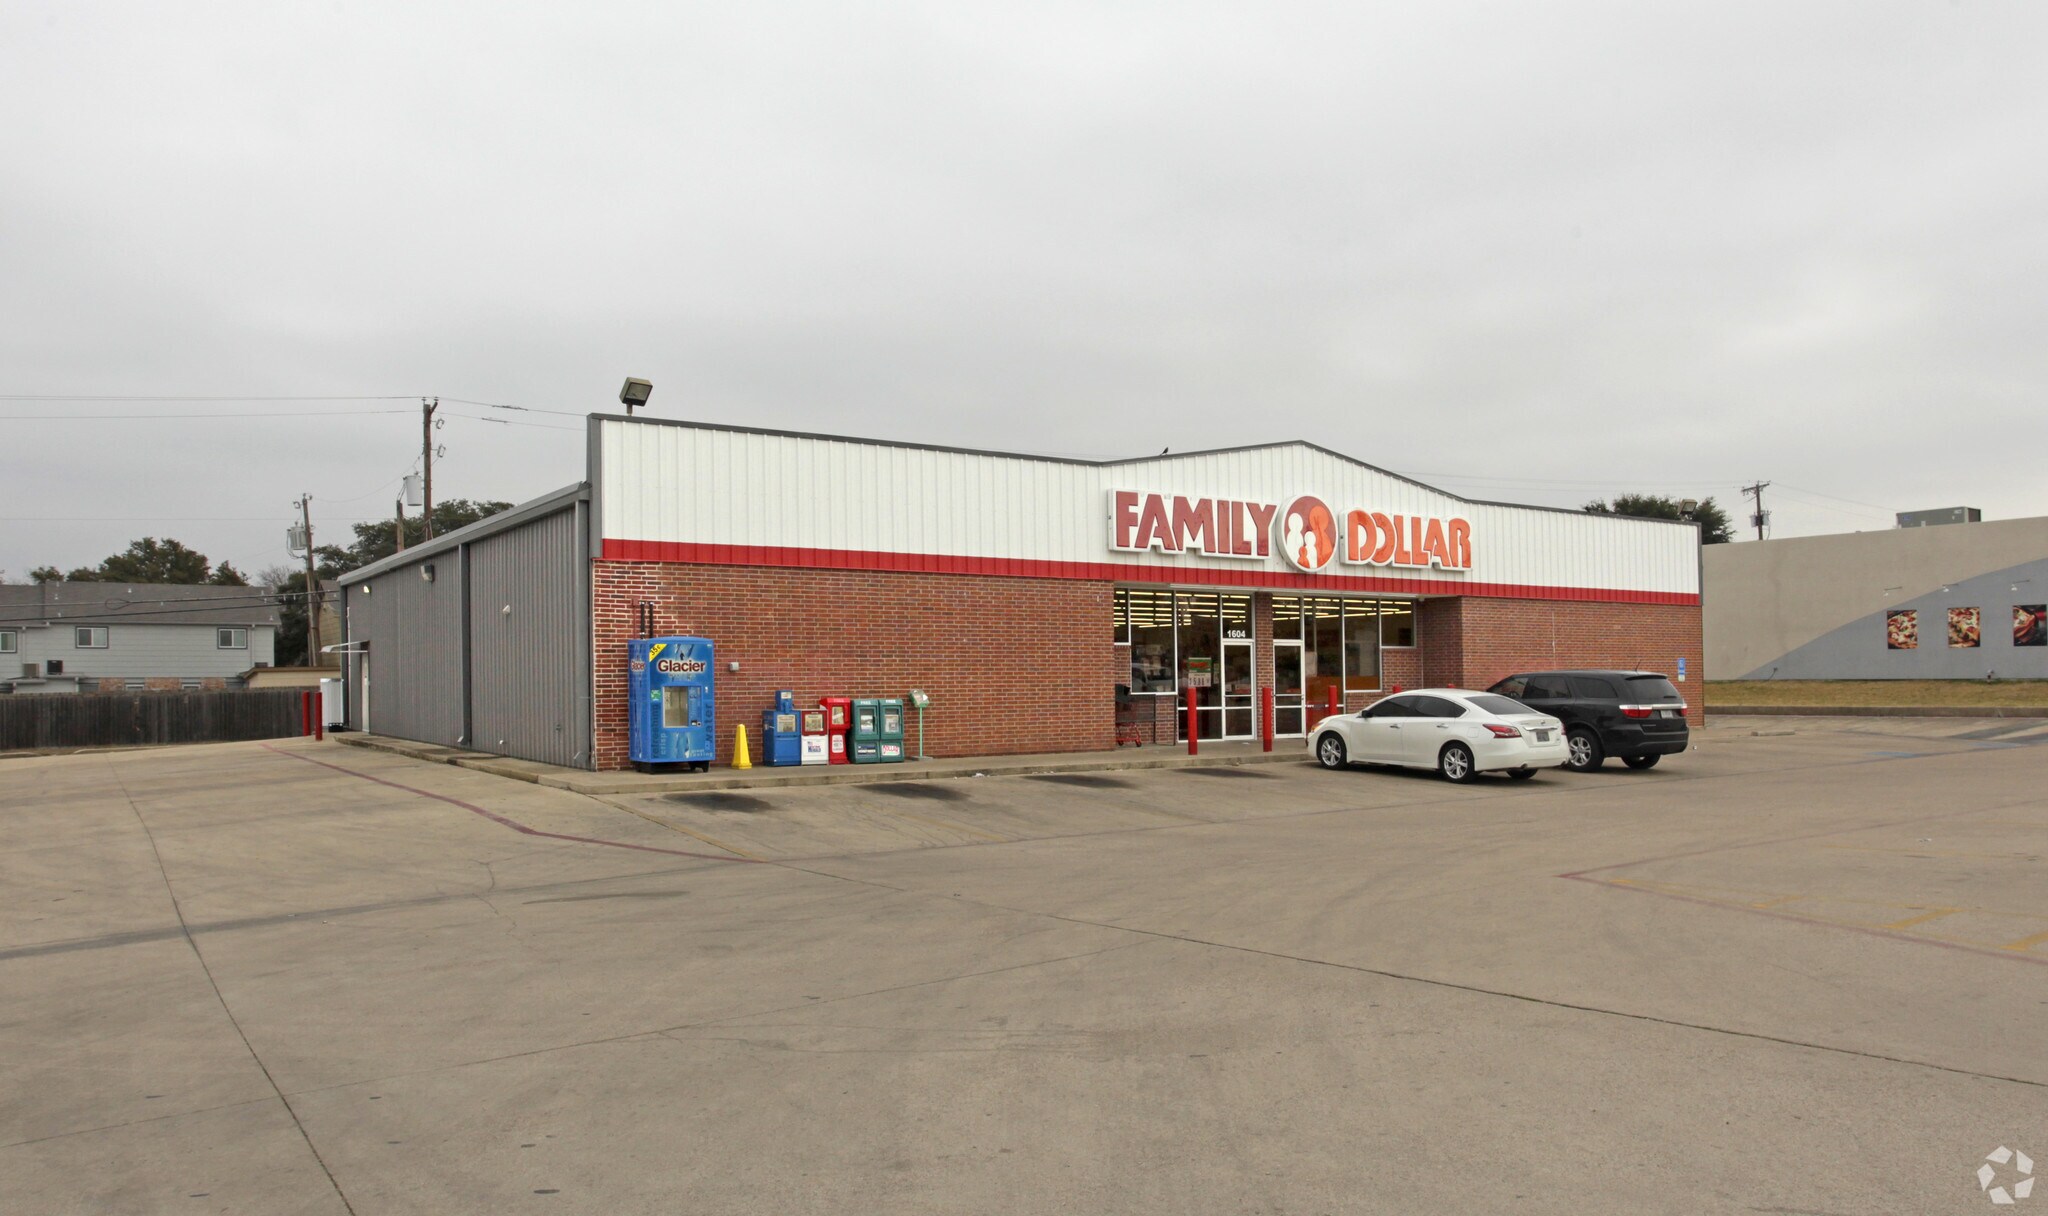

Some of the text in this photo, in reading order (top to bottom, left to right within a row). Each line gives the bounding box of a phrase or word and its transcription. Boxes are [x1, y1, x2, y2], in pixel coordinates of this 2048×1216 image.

[1116, 491, 1472, 568] FAMILY DOLLAR
[1227, 630, 1246, 638] 1604
[657, 659, 706, 672] Glacier
[704, 704, 713, 743] water
